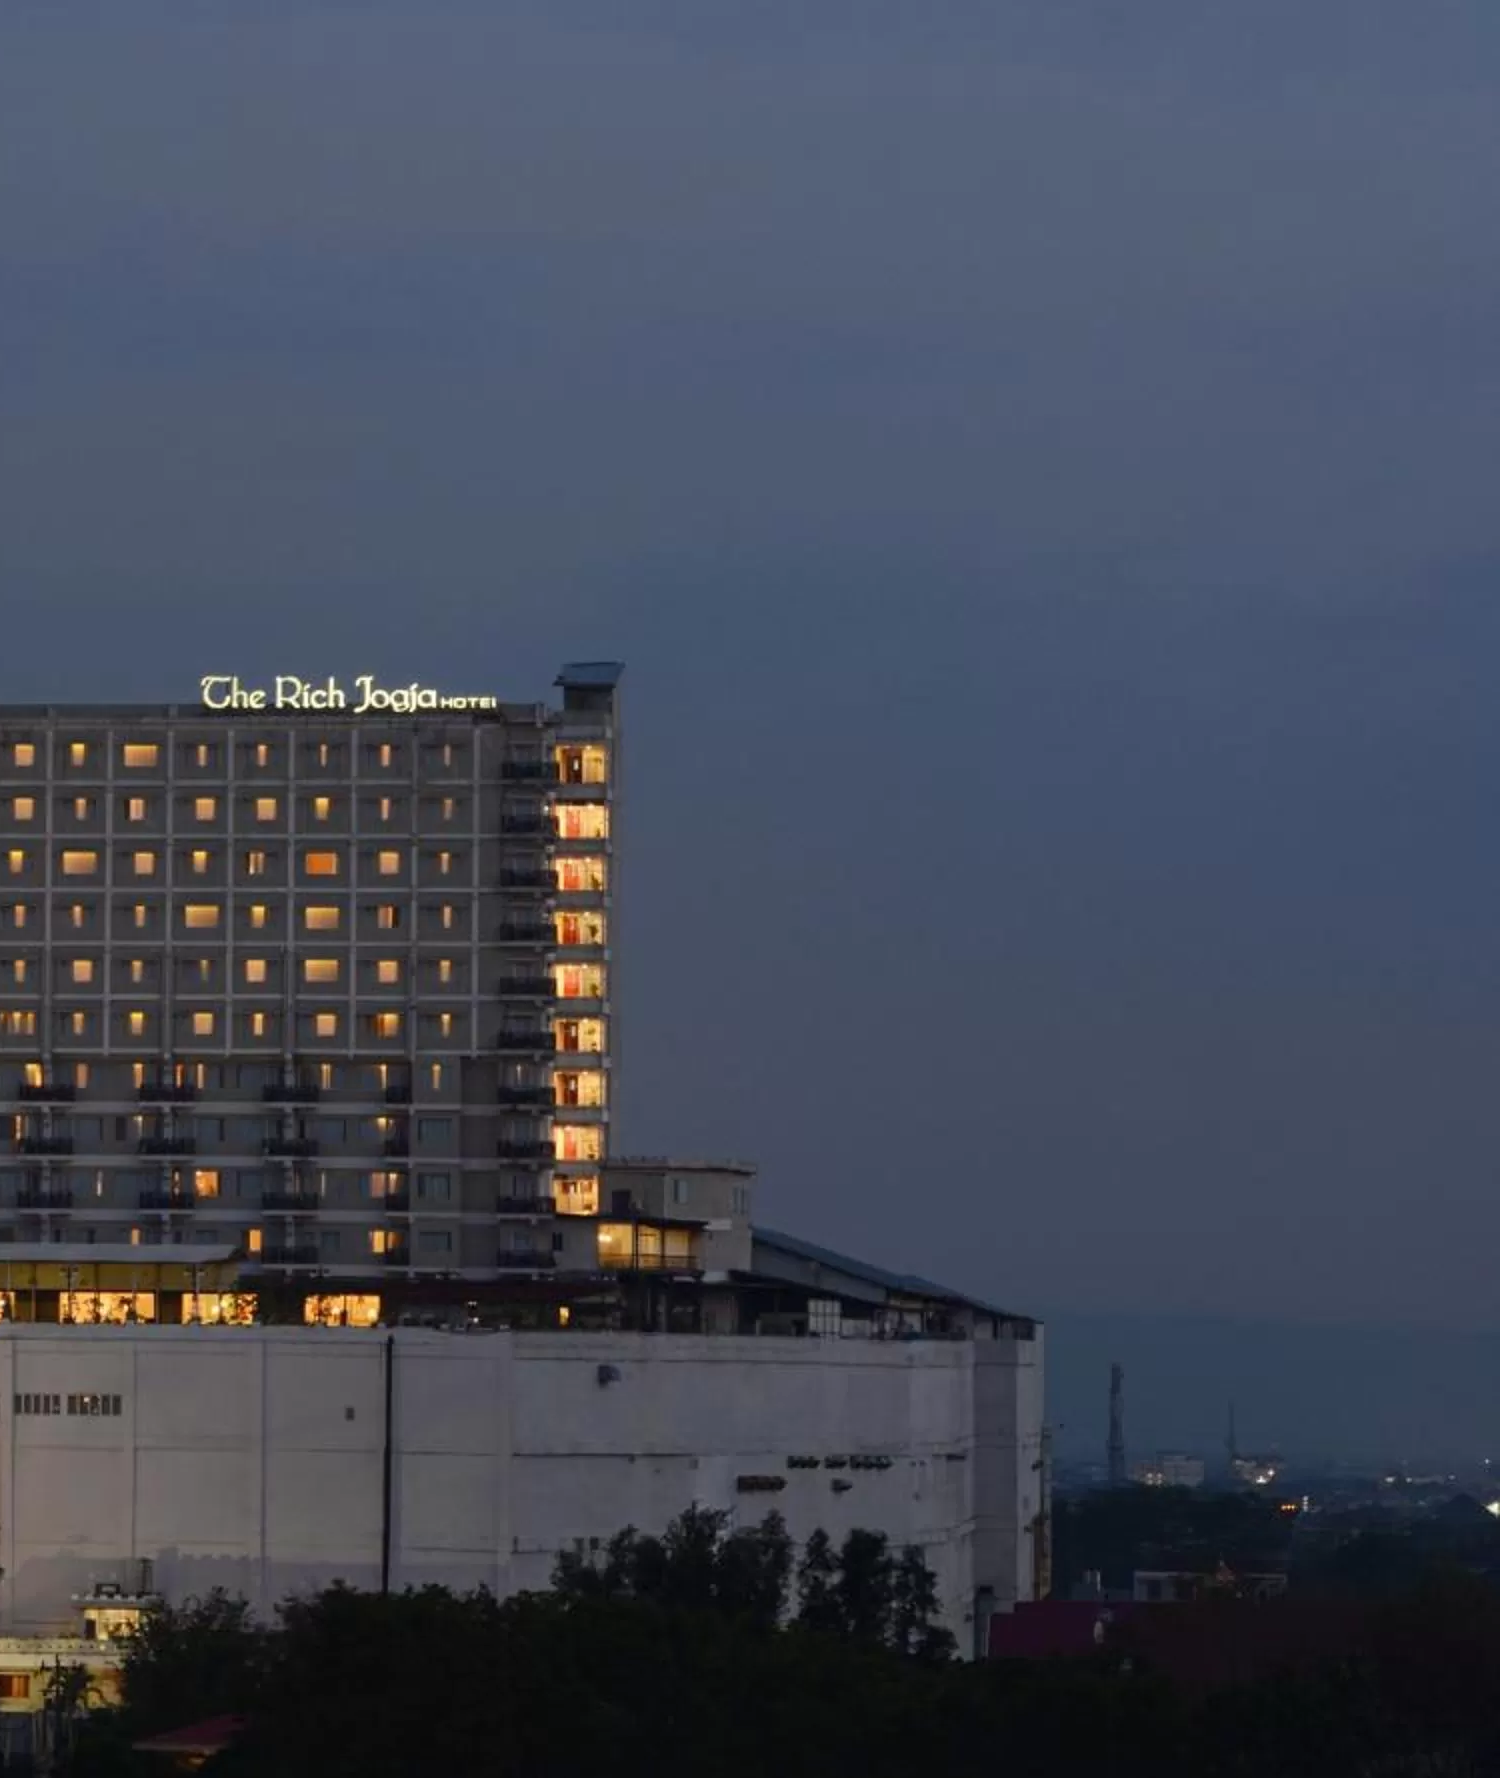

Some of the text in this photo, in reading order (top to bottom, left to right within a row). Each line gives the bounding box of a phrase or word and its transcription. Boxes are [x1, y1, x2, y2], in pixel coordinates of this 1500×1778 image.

[200, 675, 266, 709] The
[275, 675, 346, 709] Rich
[353, 675, 438, 713] Jogja
